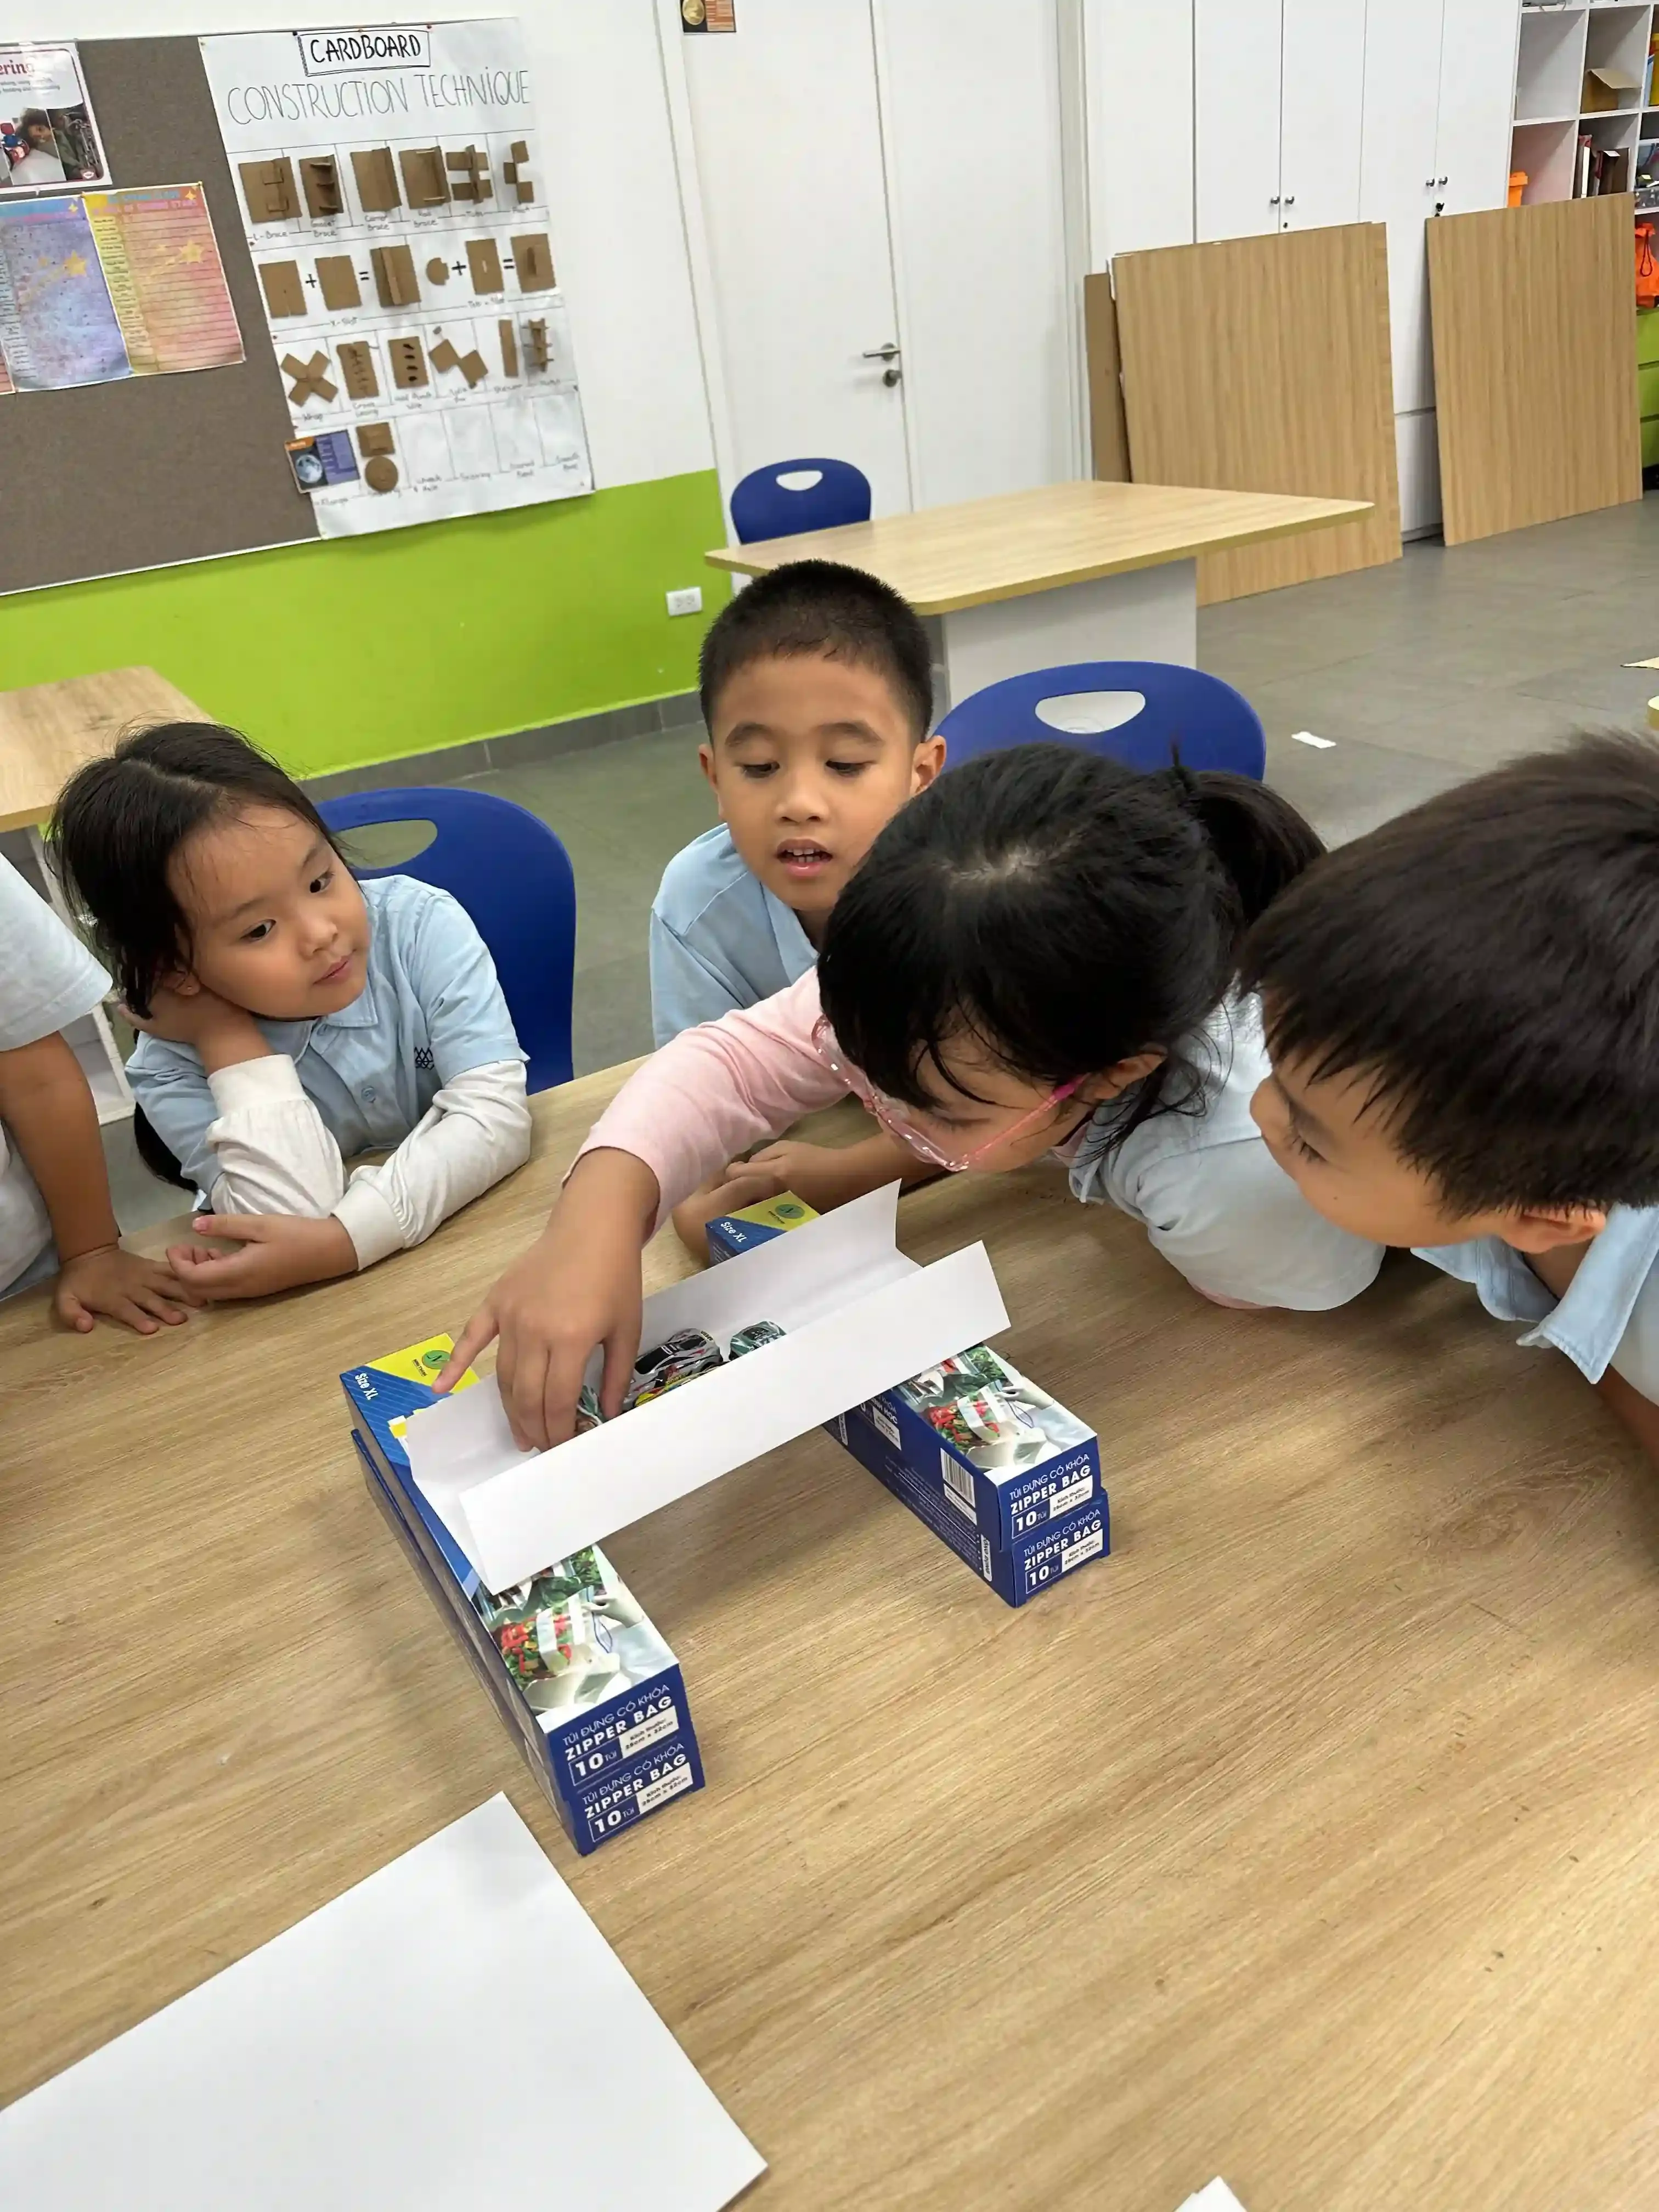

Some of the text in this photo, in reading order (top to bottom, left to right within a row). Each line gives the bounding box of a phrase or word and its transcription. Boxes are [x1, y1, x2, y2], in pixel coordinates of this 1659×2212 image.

[310, 34, 421, 63] CARDBOARD
[720, 1221, 747, 1243] Size XL
[354, 1373, 379, 1400] Size XL
[1009, 1487, 1021, 1500] TÚI
[1049, 1465, 1064, 1479] CÓ
[1065, 1454, 1090, 1471] KHÓA
[1010, 1482, 1057, 1515] ZIPPER
[1062, 1465, 1091, 1487] BAG
[1016, 1511, 1037, 1531] 10
[1023, 1544, 1035, 1557] TÚI
[1062, 1521, 1076, 1534] CÓ
[1077, 1509, 1101, 1527] KHÓA
[1024, 1519, 1102, 1570] ZIPPER BAG
[1029, 1566, 1049, 1585] 10
[563, 1732, 579, 1746] TÚI
[617, 1700, 636, 1717] CÓ
[637, 1684, 670, 1706] KHÓA
[565, 1696, 672, 1761] ZIPPER BAG
[575, 1753, 603, 1776] 10
[582, 1792, 597, 1804] TÚI
[634, 1759, 652, 1775] CÓ
[653, 1743, 685, 1765] KHÓA
[584, 1753, 686, 1819] ZIPPER BAG
[594, 1810, 622, 1833] 10
